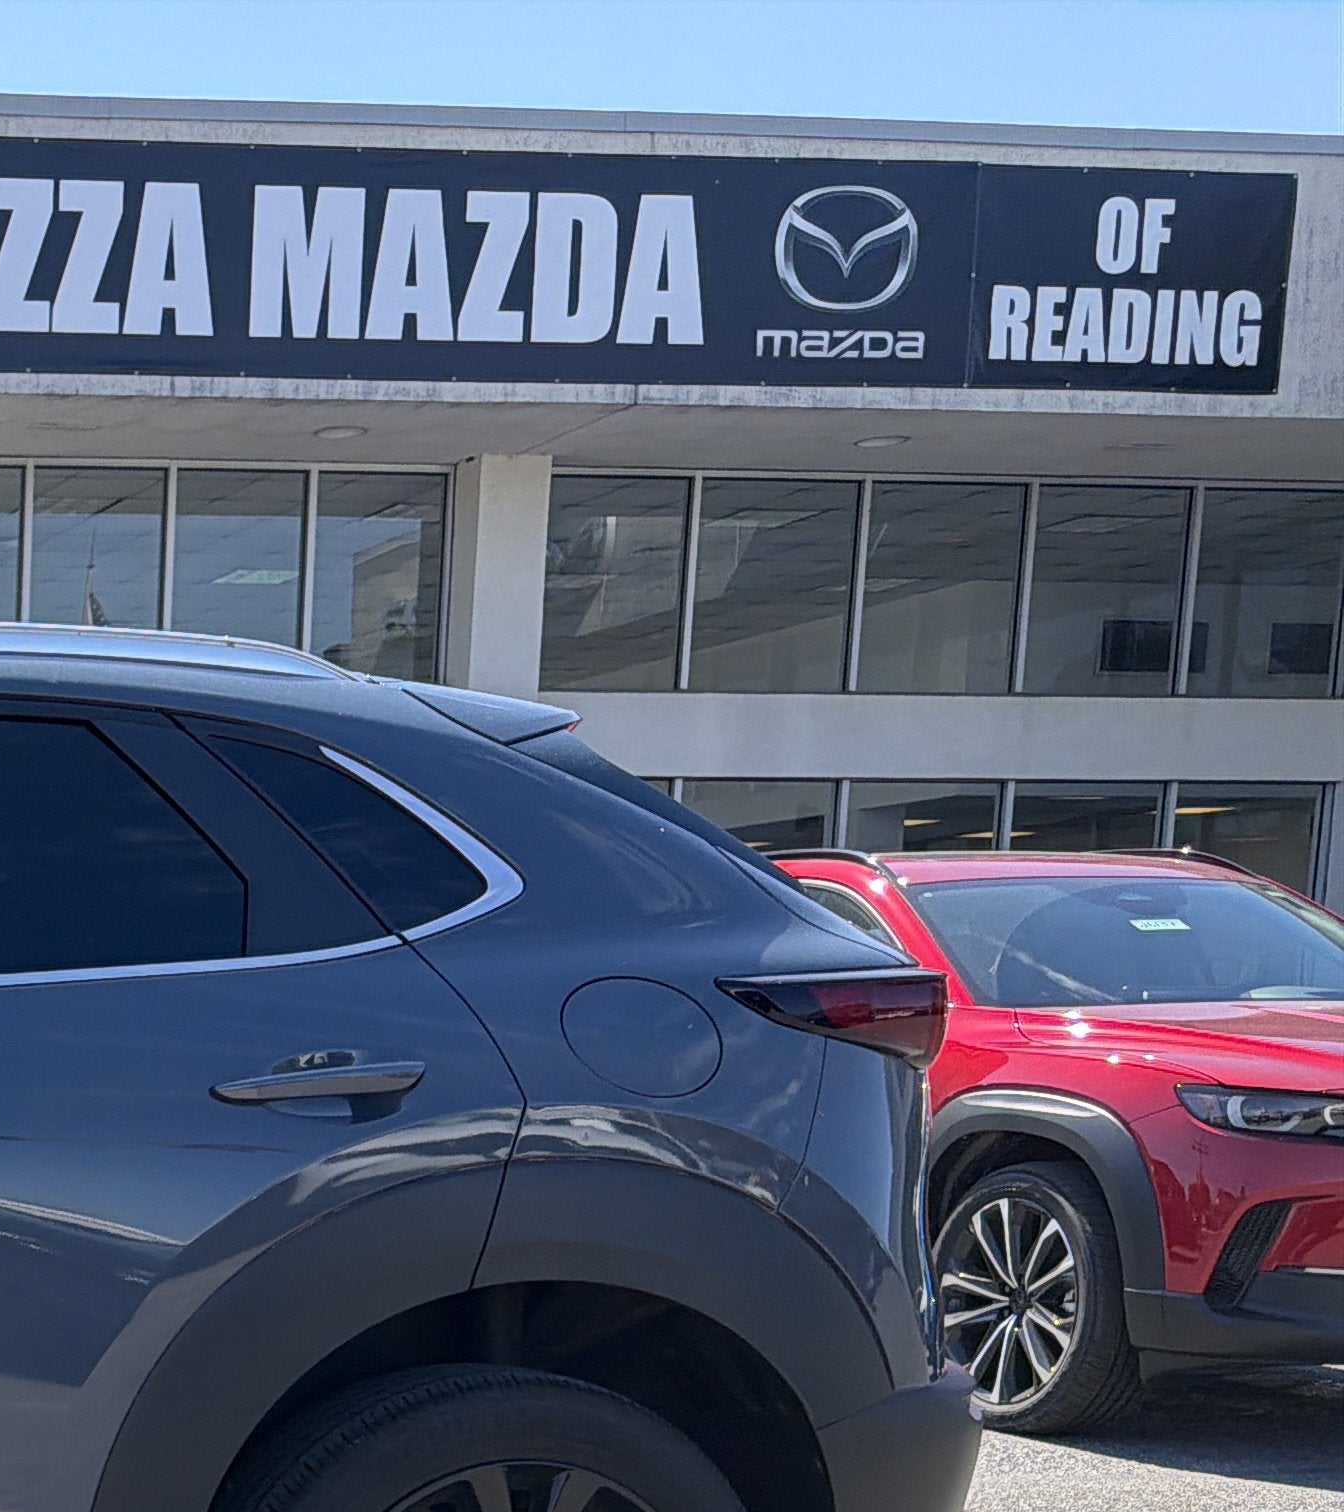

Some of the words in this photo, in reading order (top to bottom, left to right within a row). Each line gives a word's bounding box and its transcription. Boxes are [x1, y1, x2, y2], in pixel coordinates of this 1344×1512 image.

[248, 184, 704, 345] MAZDA
[1094, 196, 1176, 275] OF
[988, 284, 1262, 367] READING
